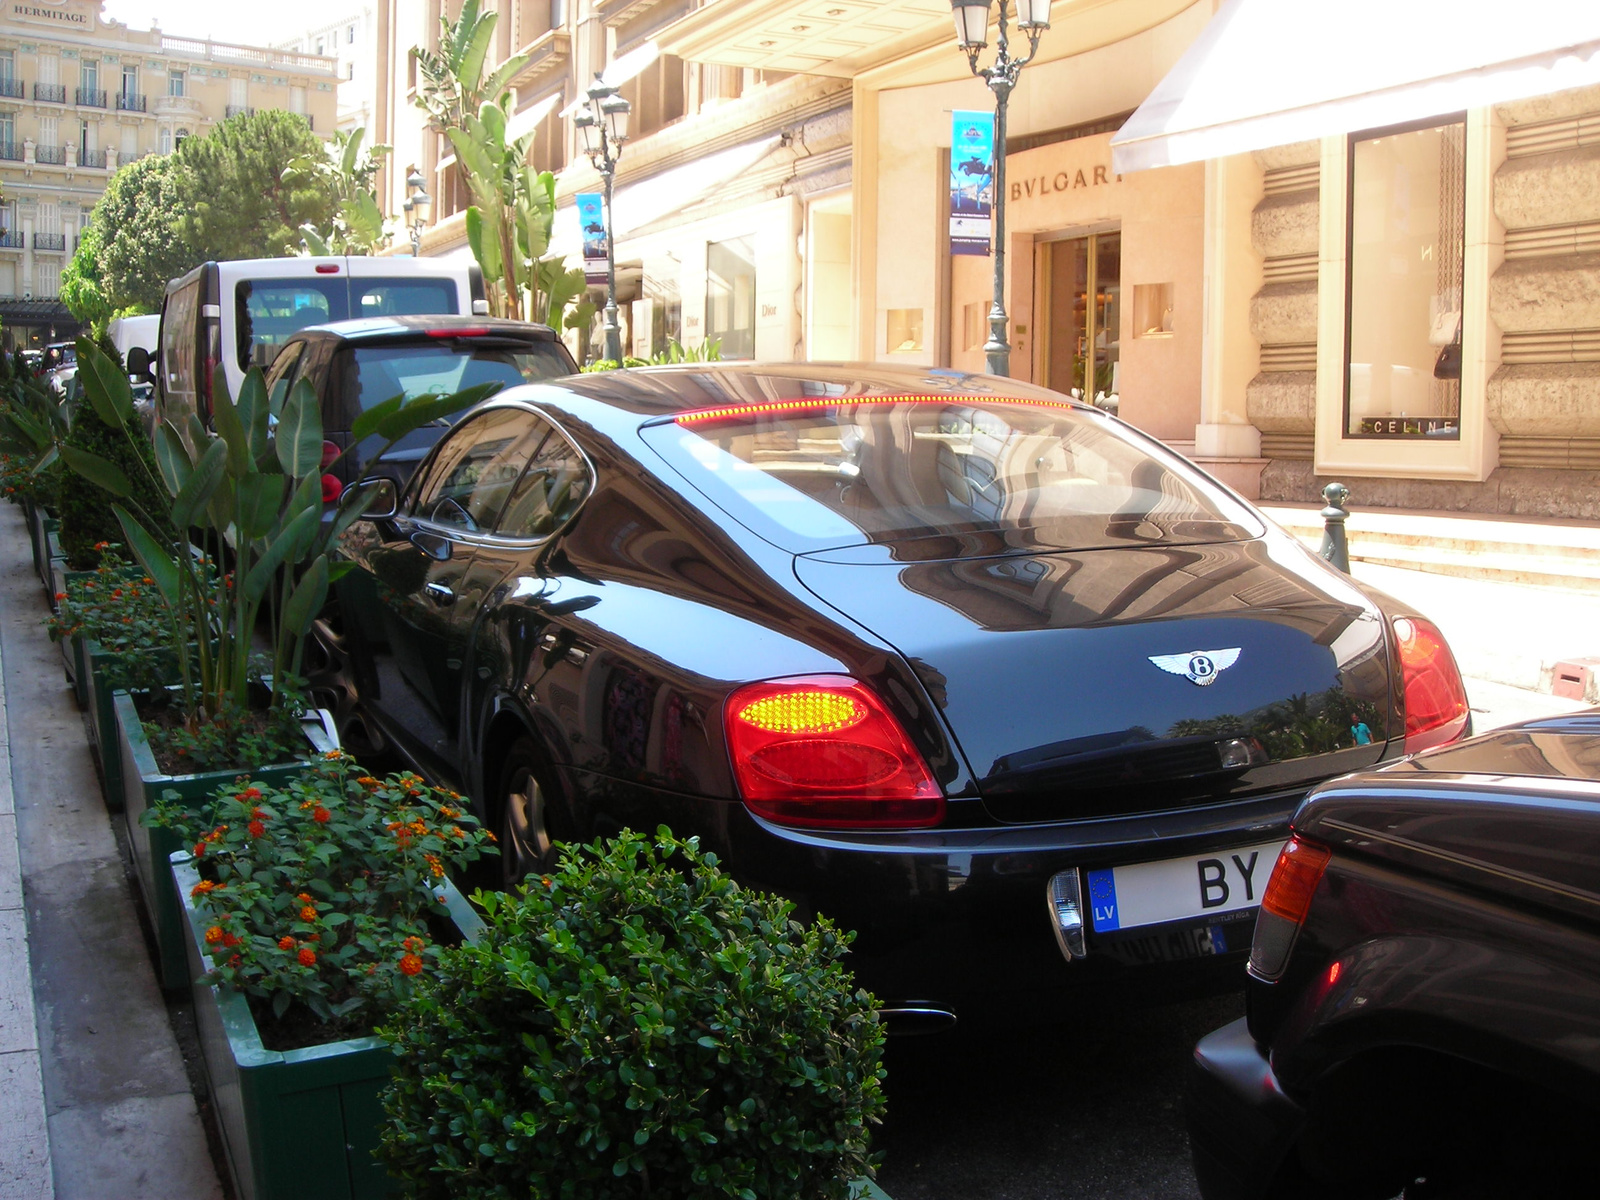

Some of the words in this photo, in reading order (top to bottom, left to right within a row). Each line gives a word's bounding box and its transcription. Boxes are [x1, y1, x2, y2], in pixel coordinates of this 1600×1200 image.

[14, 5, 87, 23] HERMITAGE
[762, 304, 777, 318] Dior
[1374, 421, 1453, 434] CELINE
[1191, 656, 1212, 677] B
[1197, 851, 1260, 909] BY
[1094, 905, 1115, 922] LV
